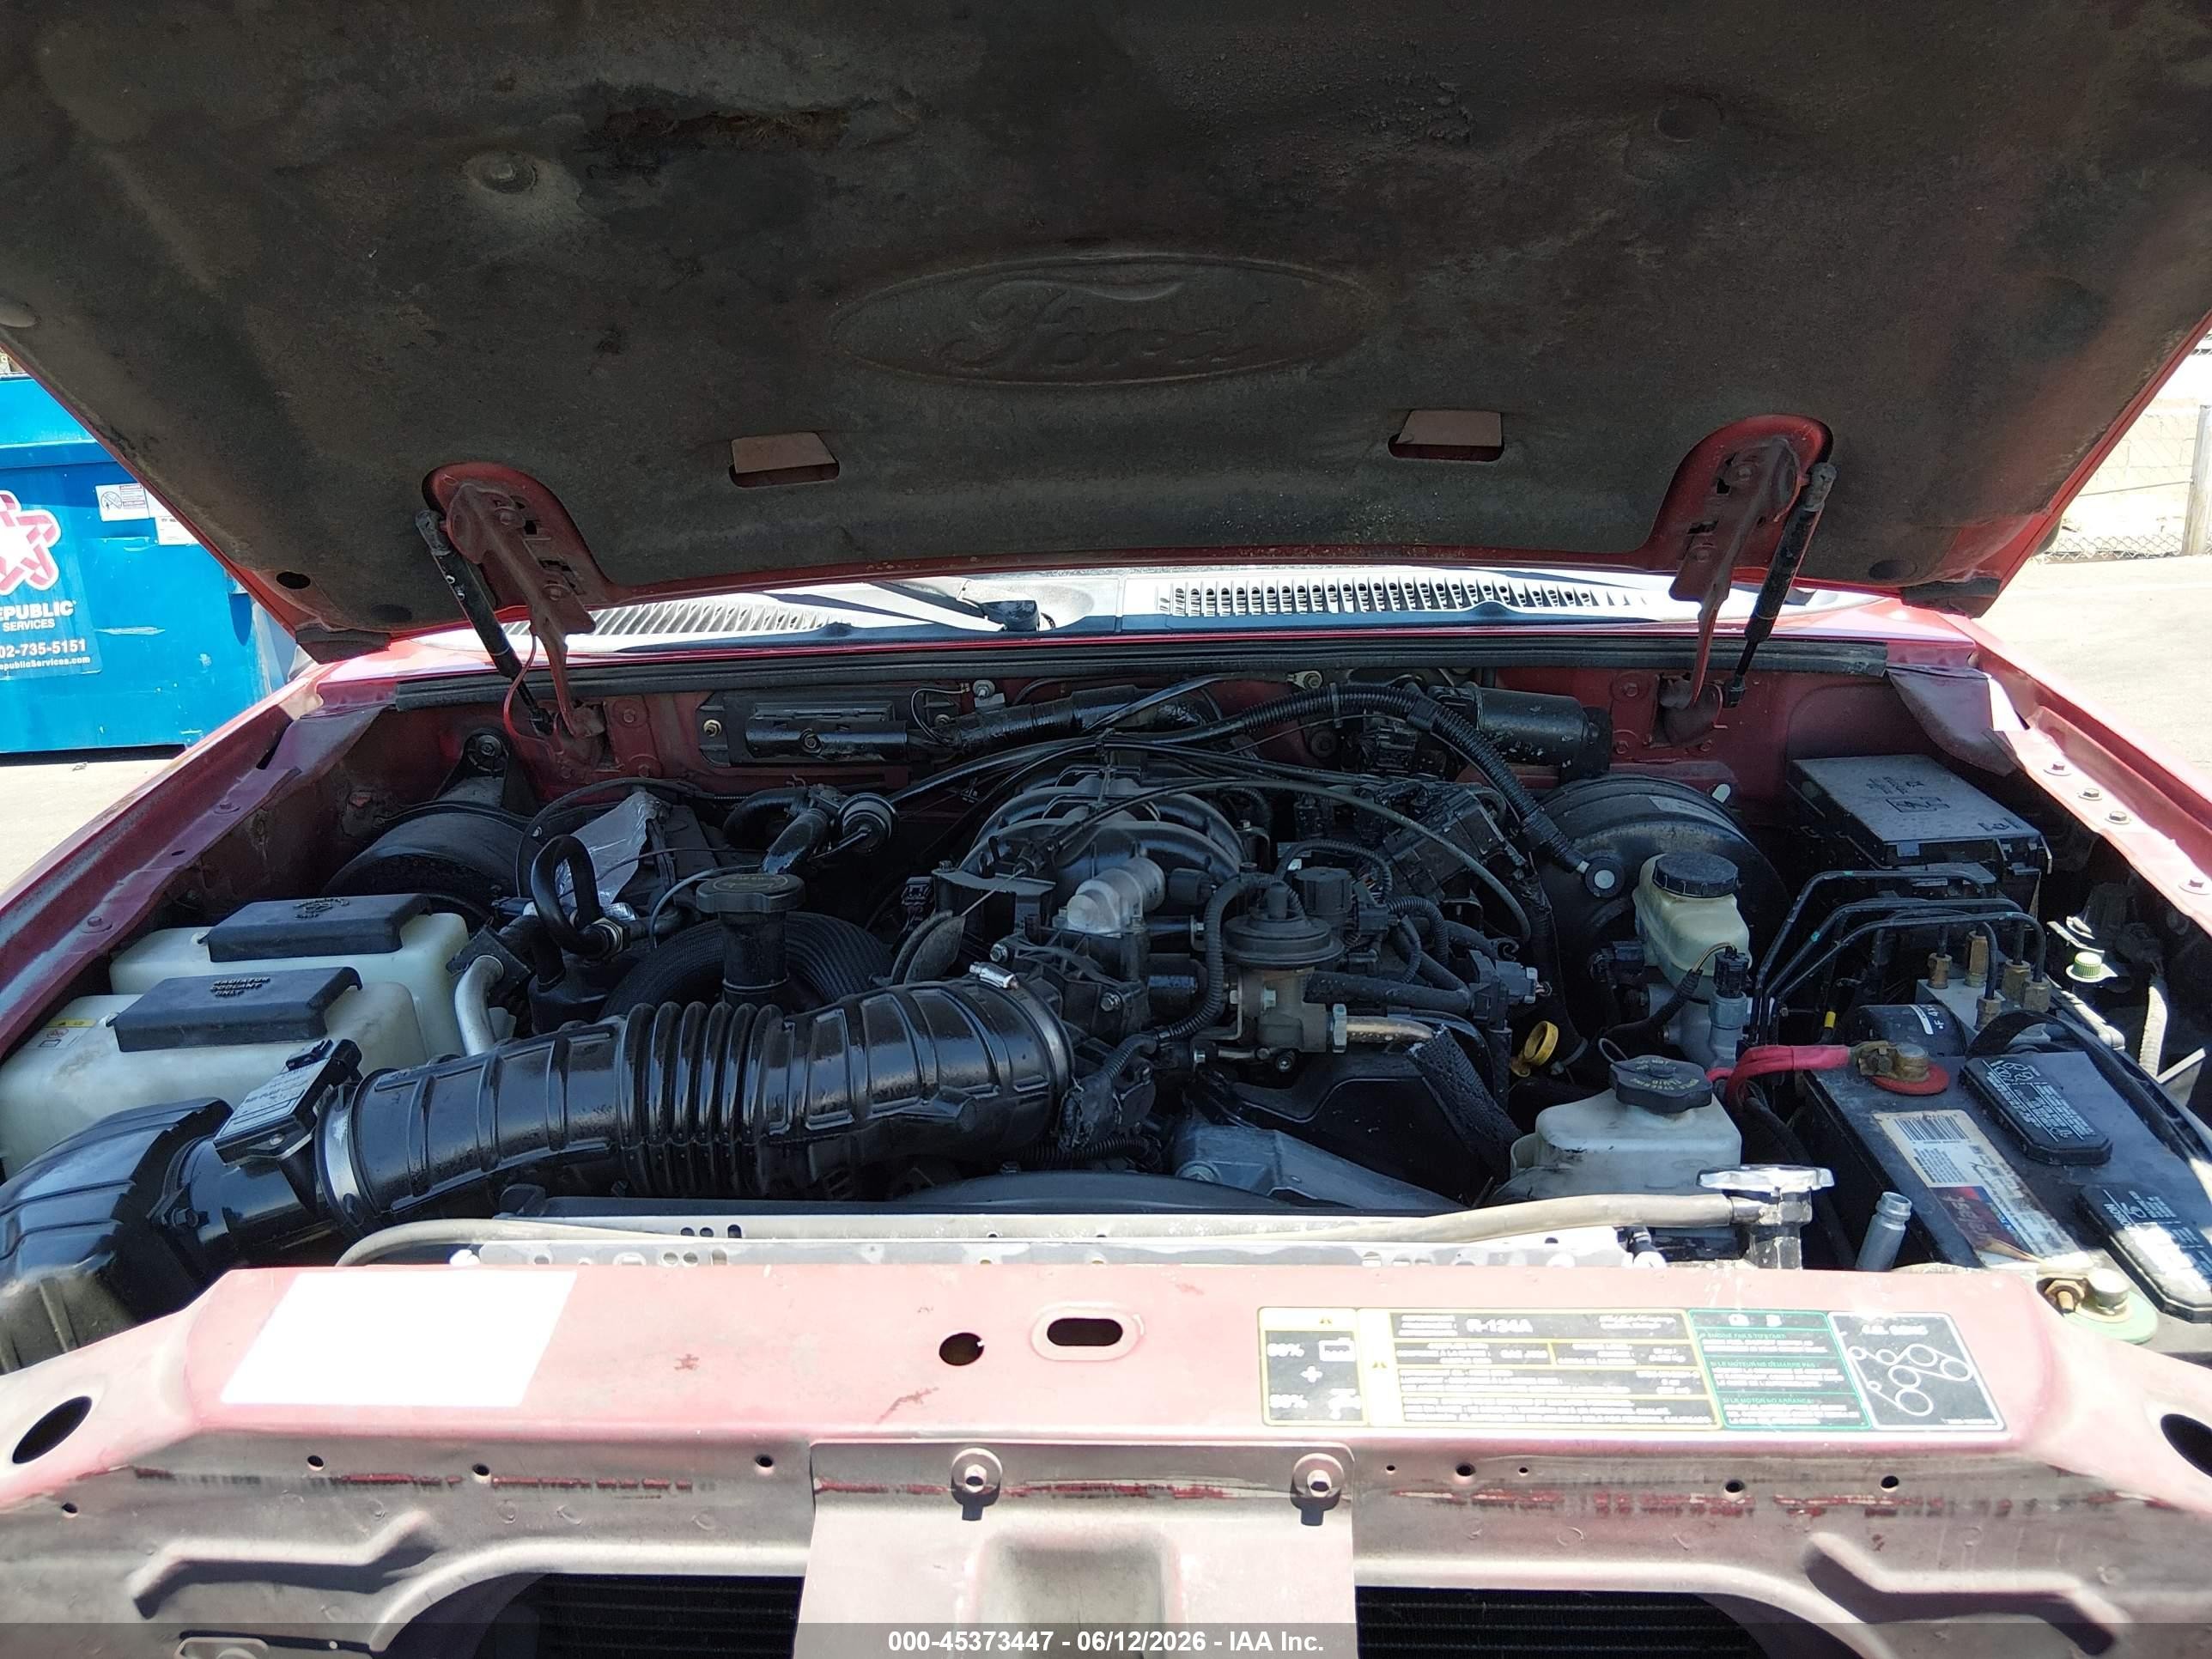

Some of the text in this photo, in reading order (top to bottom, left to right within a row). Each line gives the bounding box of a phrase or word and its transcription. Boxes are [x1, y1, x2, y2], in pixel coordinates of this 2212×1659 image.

[934, 277, 1272, 371] Ford
[3, 618, 55, 632] SERVICES
[2104, 1203, 2137, 1231] POISON
